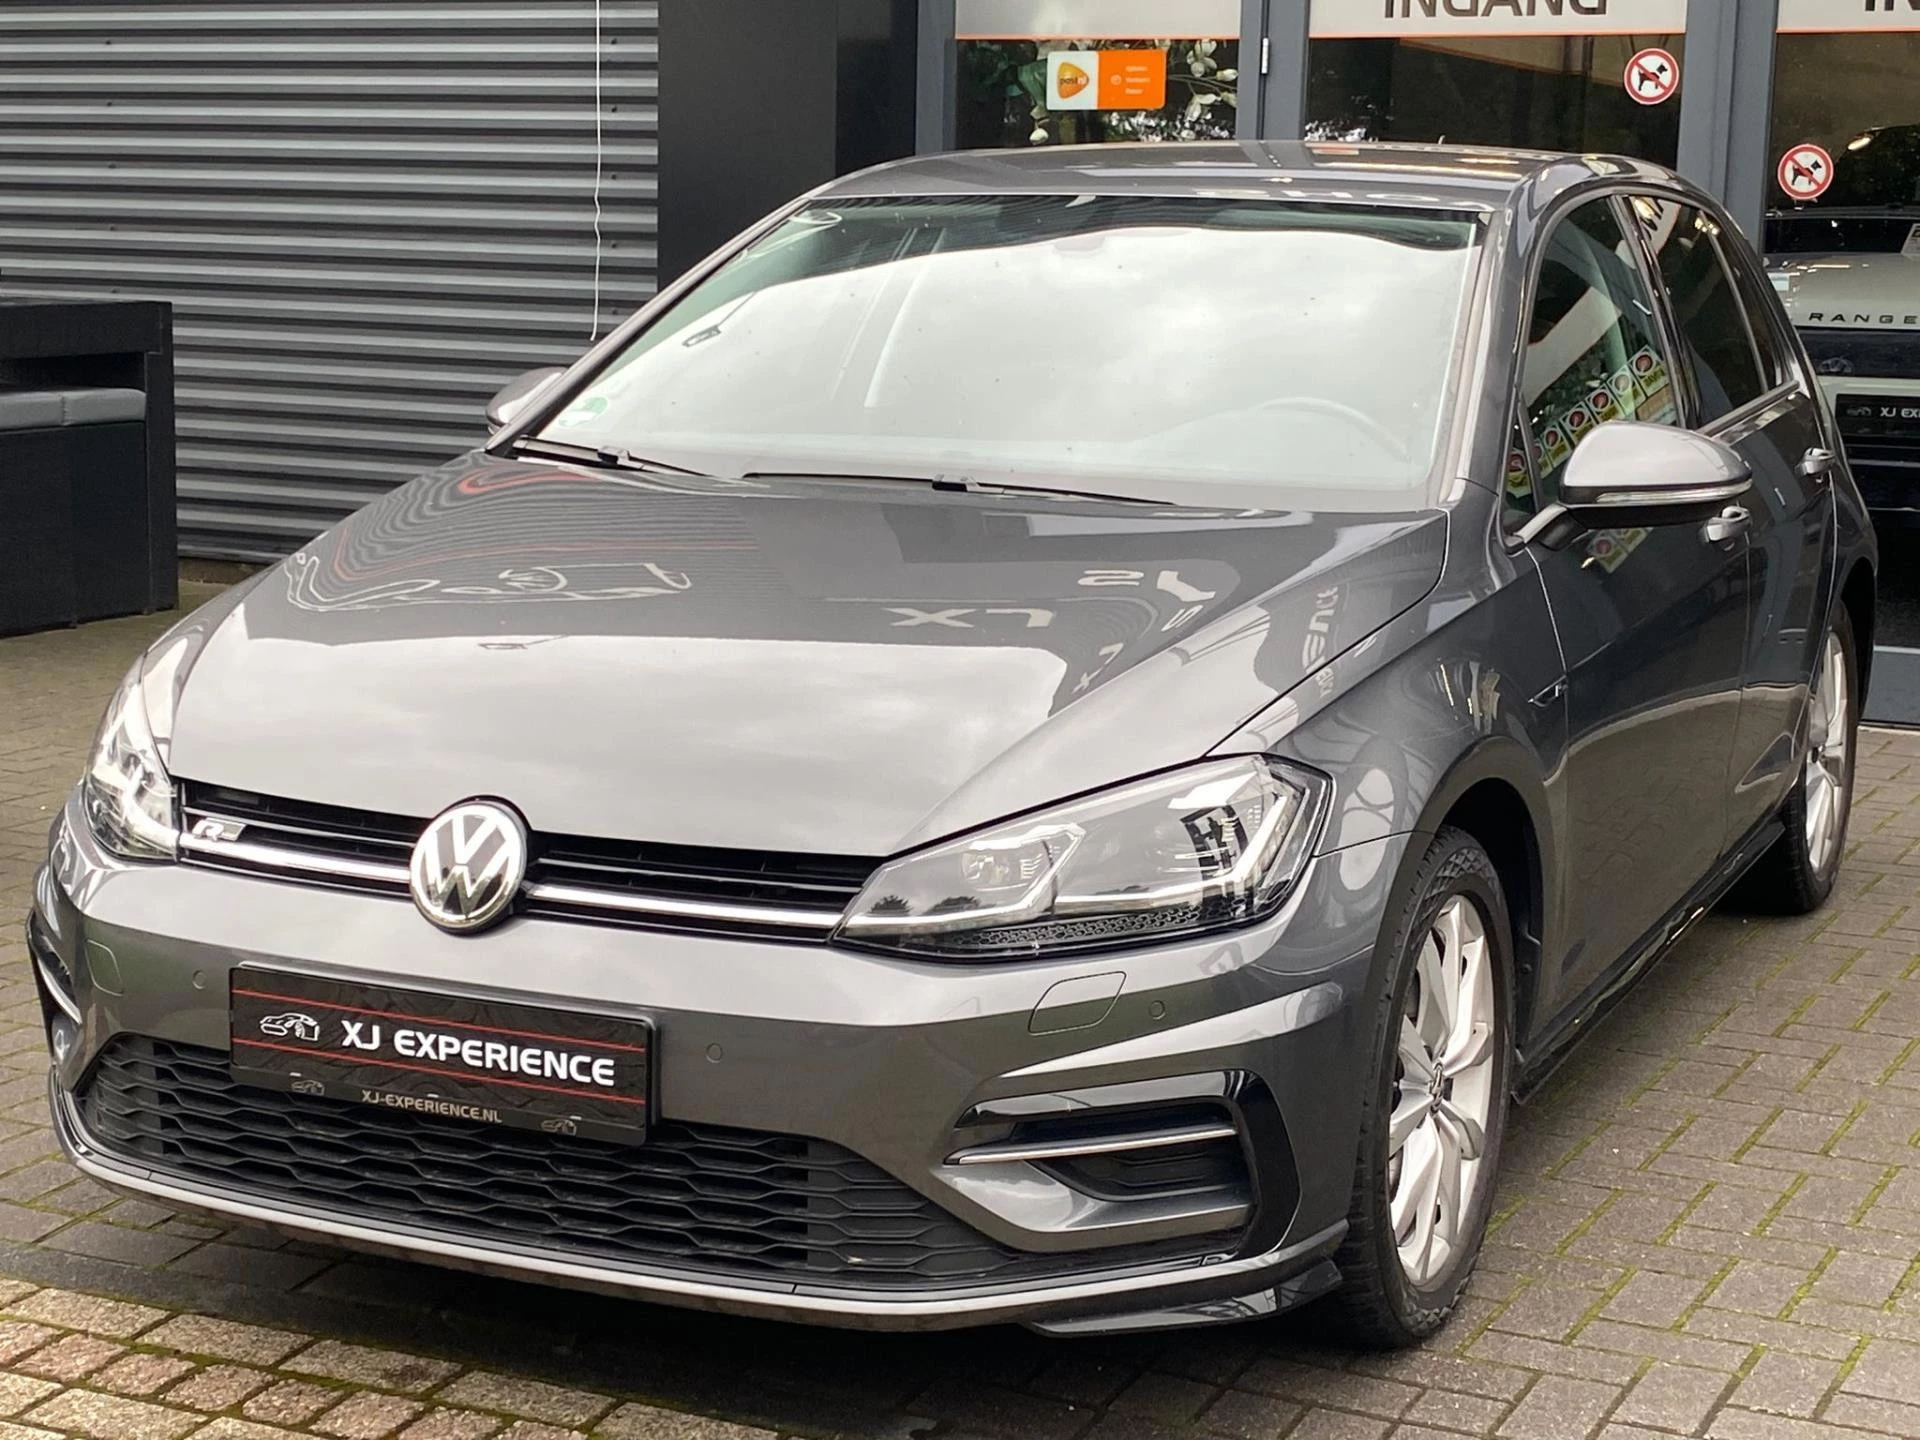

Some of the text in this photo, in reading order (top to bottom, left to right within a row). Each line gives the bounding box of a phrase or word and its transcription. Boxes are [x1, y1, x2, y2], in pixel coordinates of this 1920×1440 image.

[1808, 312, 1918, 325] RANGE
[1880, 406, 1920, 419] XJ EX
[341, 1019, 615, 1087] XJ EXPERIENCE
[361, 1088, 503, 1124] XJ-EXPERIENCE.NL
